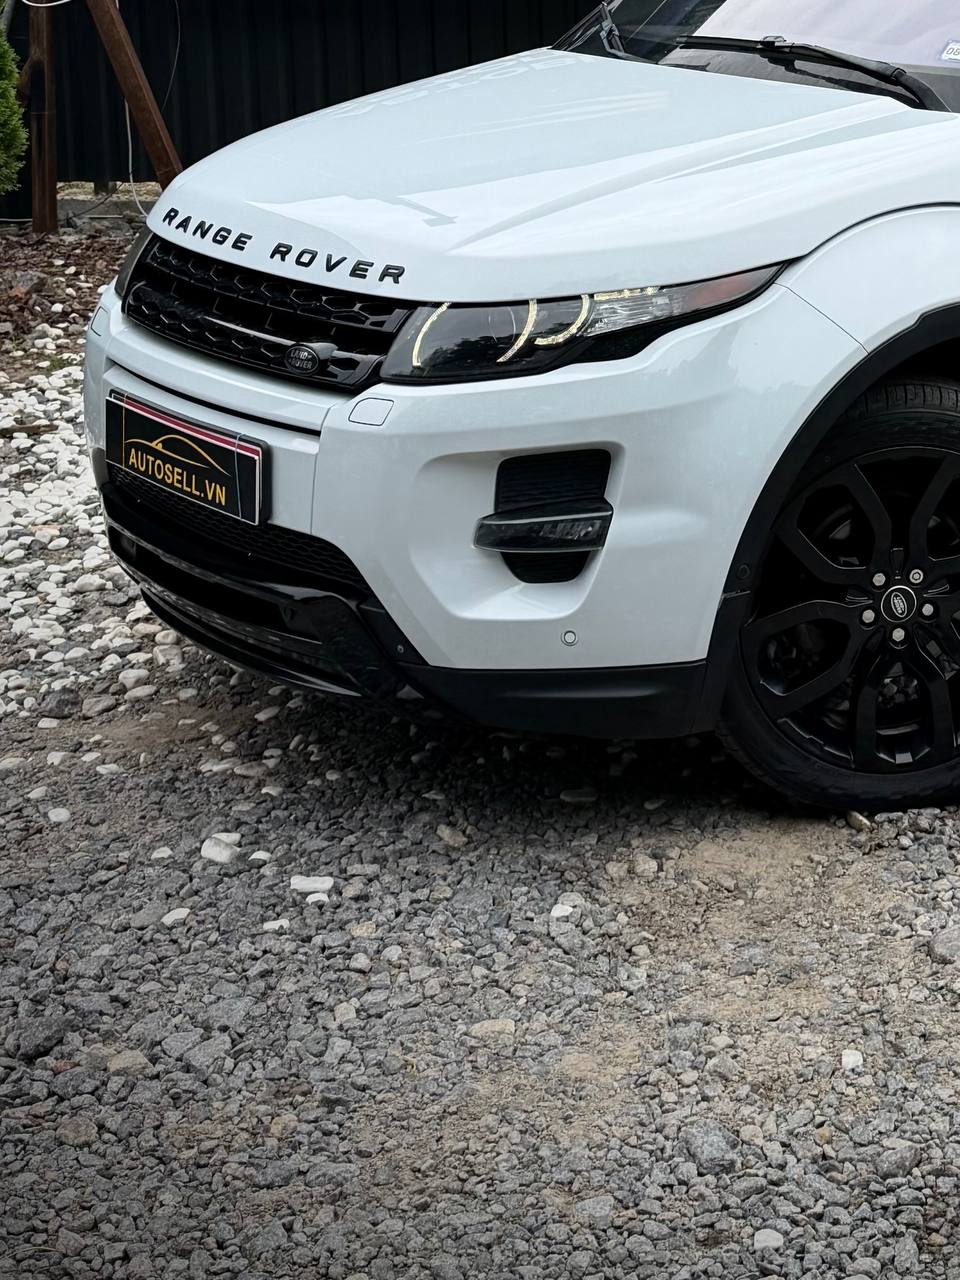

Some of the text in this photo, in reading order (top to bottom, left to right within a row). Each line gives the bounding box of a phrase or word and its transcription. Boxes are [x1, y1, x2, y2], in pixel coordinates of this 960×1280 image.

[162, 207, 406, 284] RANGE ROVER
[128, 448, 226, 506] AUTOSELL.VN
